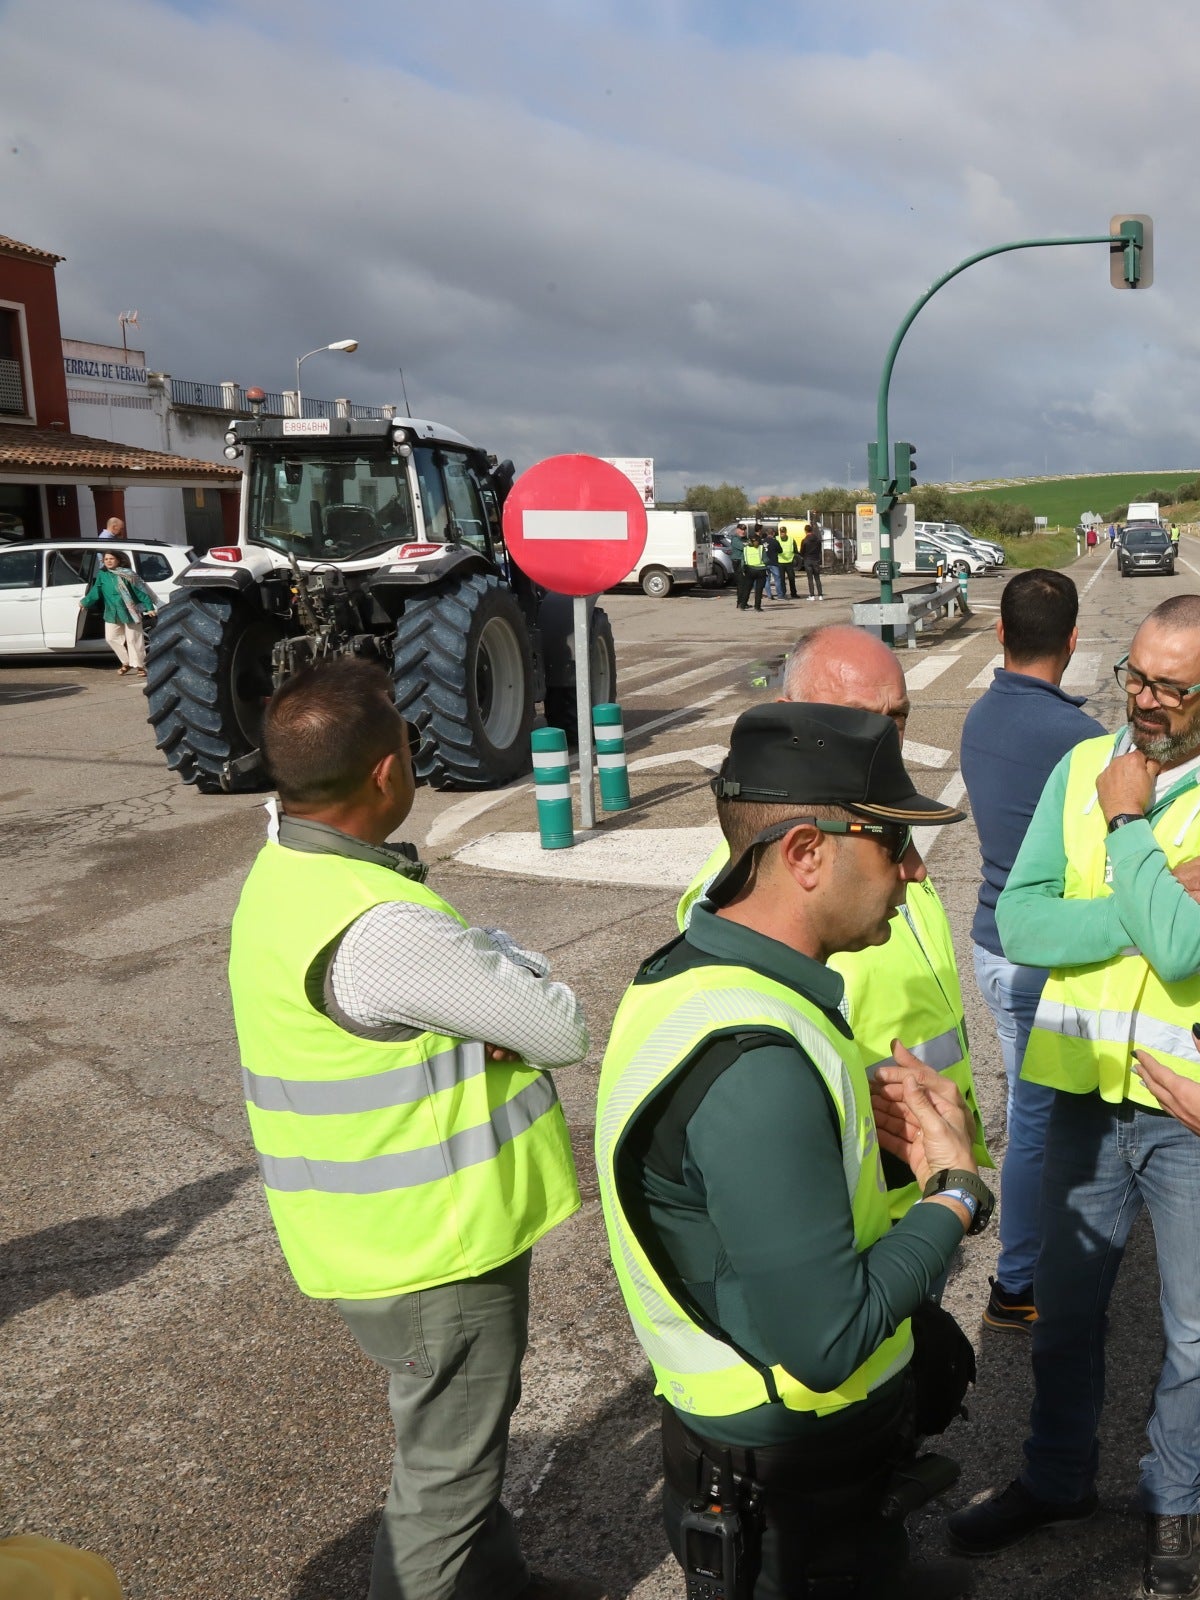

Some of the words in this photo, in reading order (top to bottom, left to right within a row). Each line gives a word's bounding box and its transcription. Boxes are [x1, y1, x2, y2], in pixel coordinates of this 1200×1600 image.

[64, 359, 100, 377] ERRAZA
[102, 363, 113, 379] DE
[116, 365, 147, 383] VERANO
